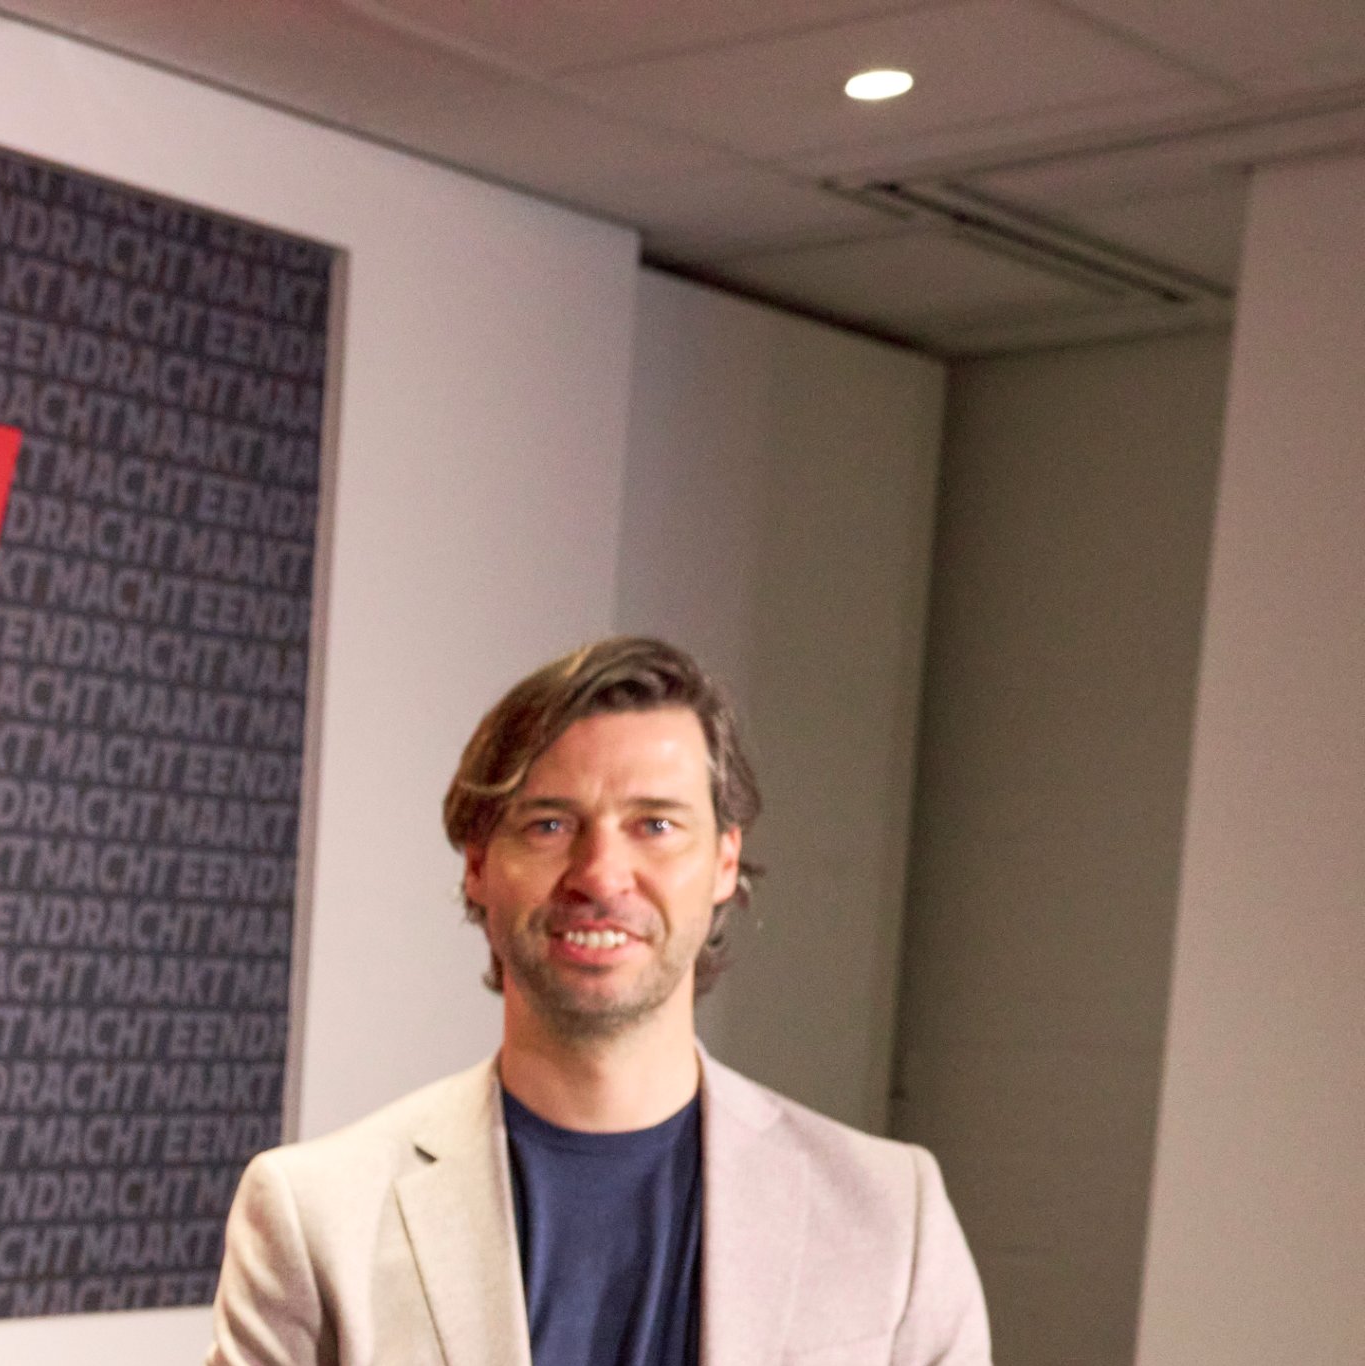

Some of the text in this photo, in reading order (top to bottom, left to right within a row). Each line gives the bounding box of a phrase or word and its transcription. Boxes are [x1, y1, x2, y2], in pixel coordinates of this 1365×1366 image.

[60, 268, 204, 348] MACHT
[121, 400, 259, 471] MAAKT
[52, 446, 195, 515] MACHT
[173, 524, 306, 587] MAAKT
[46, 555, 189, 625] MACHT
[106, 678, 244, 742] MAAKT
[38, 727, 183, 788] MACHT
[160, 796, 292, 847] MAAKT
[32, 835, 177, 896] MACHT
[93, 954, 232, 1003] MAAKT
[23, 1006, 168, 1057] MACHT
[147, 1061, 279, 1107] MAAKT
[19, 1115, 164, 1165] MACHT
[77, 1220, 217, 1273] MAAKT
